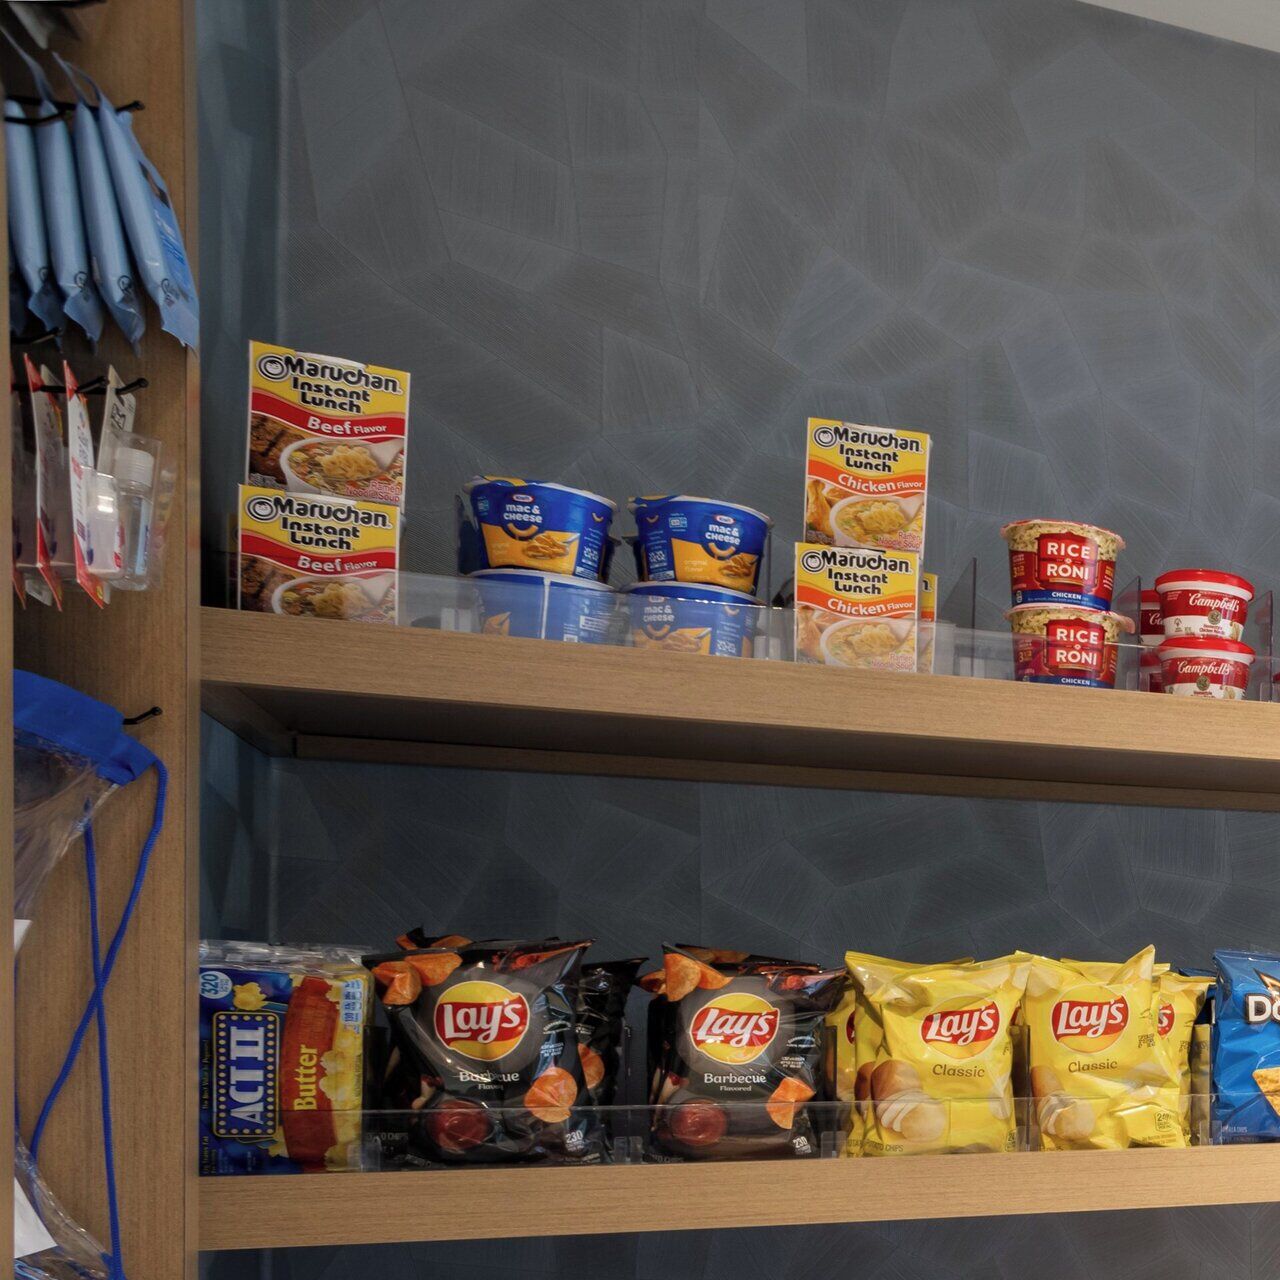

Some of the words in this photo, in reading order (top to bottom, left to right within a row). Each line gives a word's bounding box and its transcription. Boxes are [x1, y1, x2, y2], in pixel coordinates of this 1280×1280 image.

[284, 356, 398, 392] Maruchan
[292, 377, 370, 402] Instant
[301, 391, 361, 413] Lunch
[307, 416, 351, 434] Beef
[353, 425, 387, 434] Flavor
[834, 427, 920, 452] Maruchan
[840, 444, 898, 462] Instant
[846, 457, 891, 473] Lunch
[838, 473, 895, 492] Chicken
[897, 482, 922, 490] Flavor
[273, 497, 388, 527] Maruchan
[282, 517, 360, 538] Instant
[290, 531, 351, 550] Lunch
[1047, 542, 1090, 559] RICE
[298, 555, 342, 572] Beef
[822, 550, 909, 572] Maruchan
[828, 569, 888, 584] Instant
[1046, 564, 1089, 580] RONI
[834, 581, 881, 595] Lunch
[1052, 591, 1082, 600] CHICKEN
[828, 598, 885, 615] Chicken
[887, 602, 913, 610] Flavor
[1056, 628, 1099, 644] RICE
[1056, 650, 1097, 665] RONI
[1061, 677, 1090, 686] CHICKEN
[201, 974, 218, 995] 320
[443, 998, 522, 1043] Lay's
[925, 1006, 995, 1046] Lay's
[1056, 999, 1125, 1038] Lay's
[697, 1008, 775, 1048] Lay's
[932, 1063, 985, 1078] Classic
[1068, 1058, 1118, 1074] Classic
[294, 1044, 318, 1110] Butter
[704, 1072, 767, 1084] Barbecue
[229, 1066, 264, 1125] ACT
